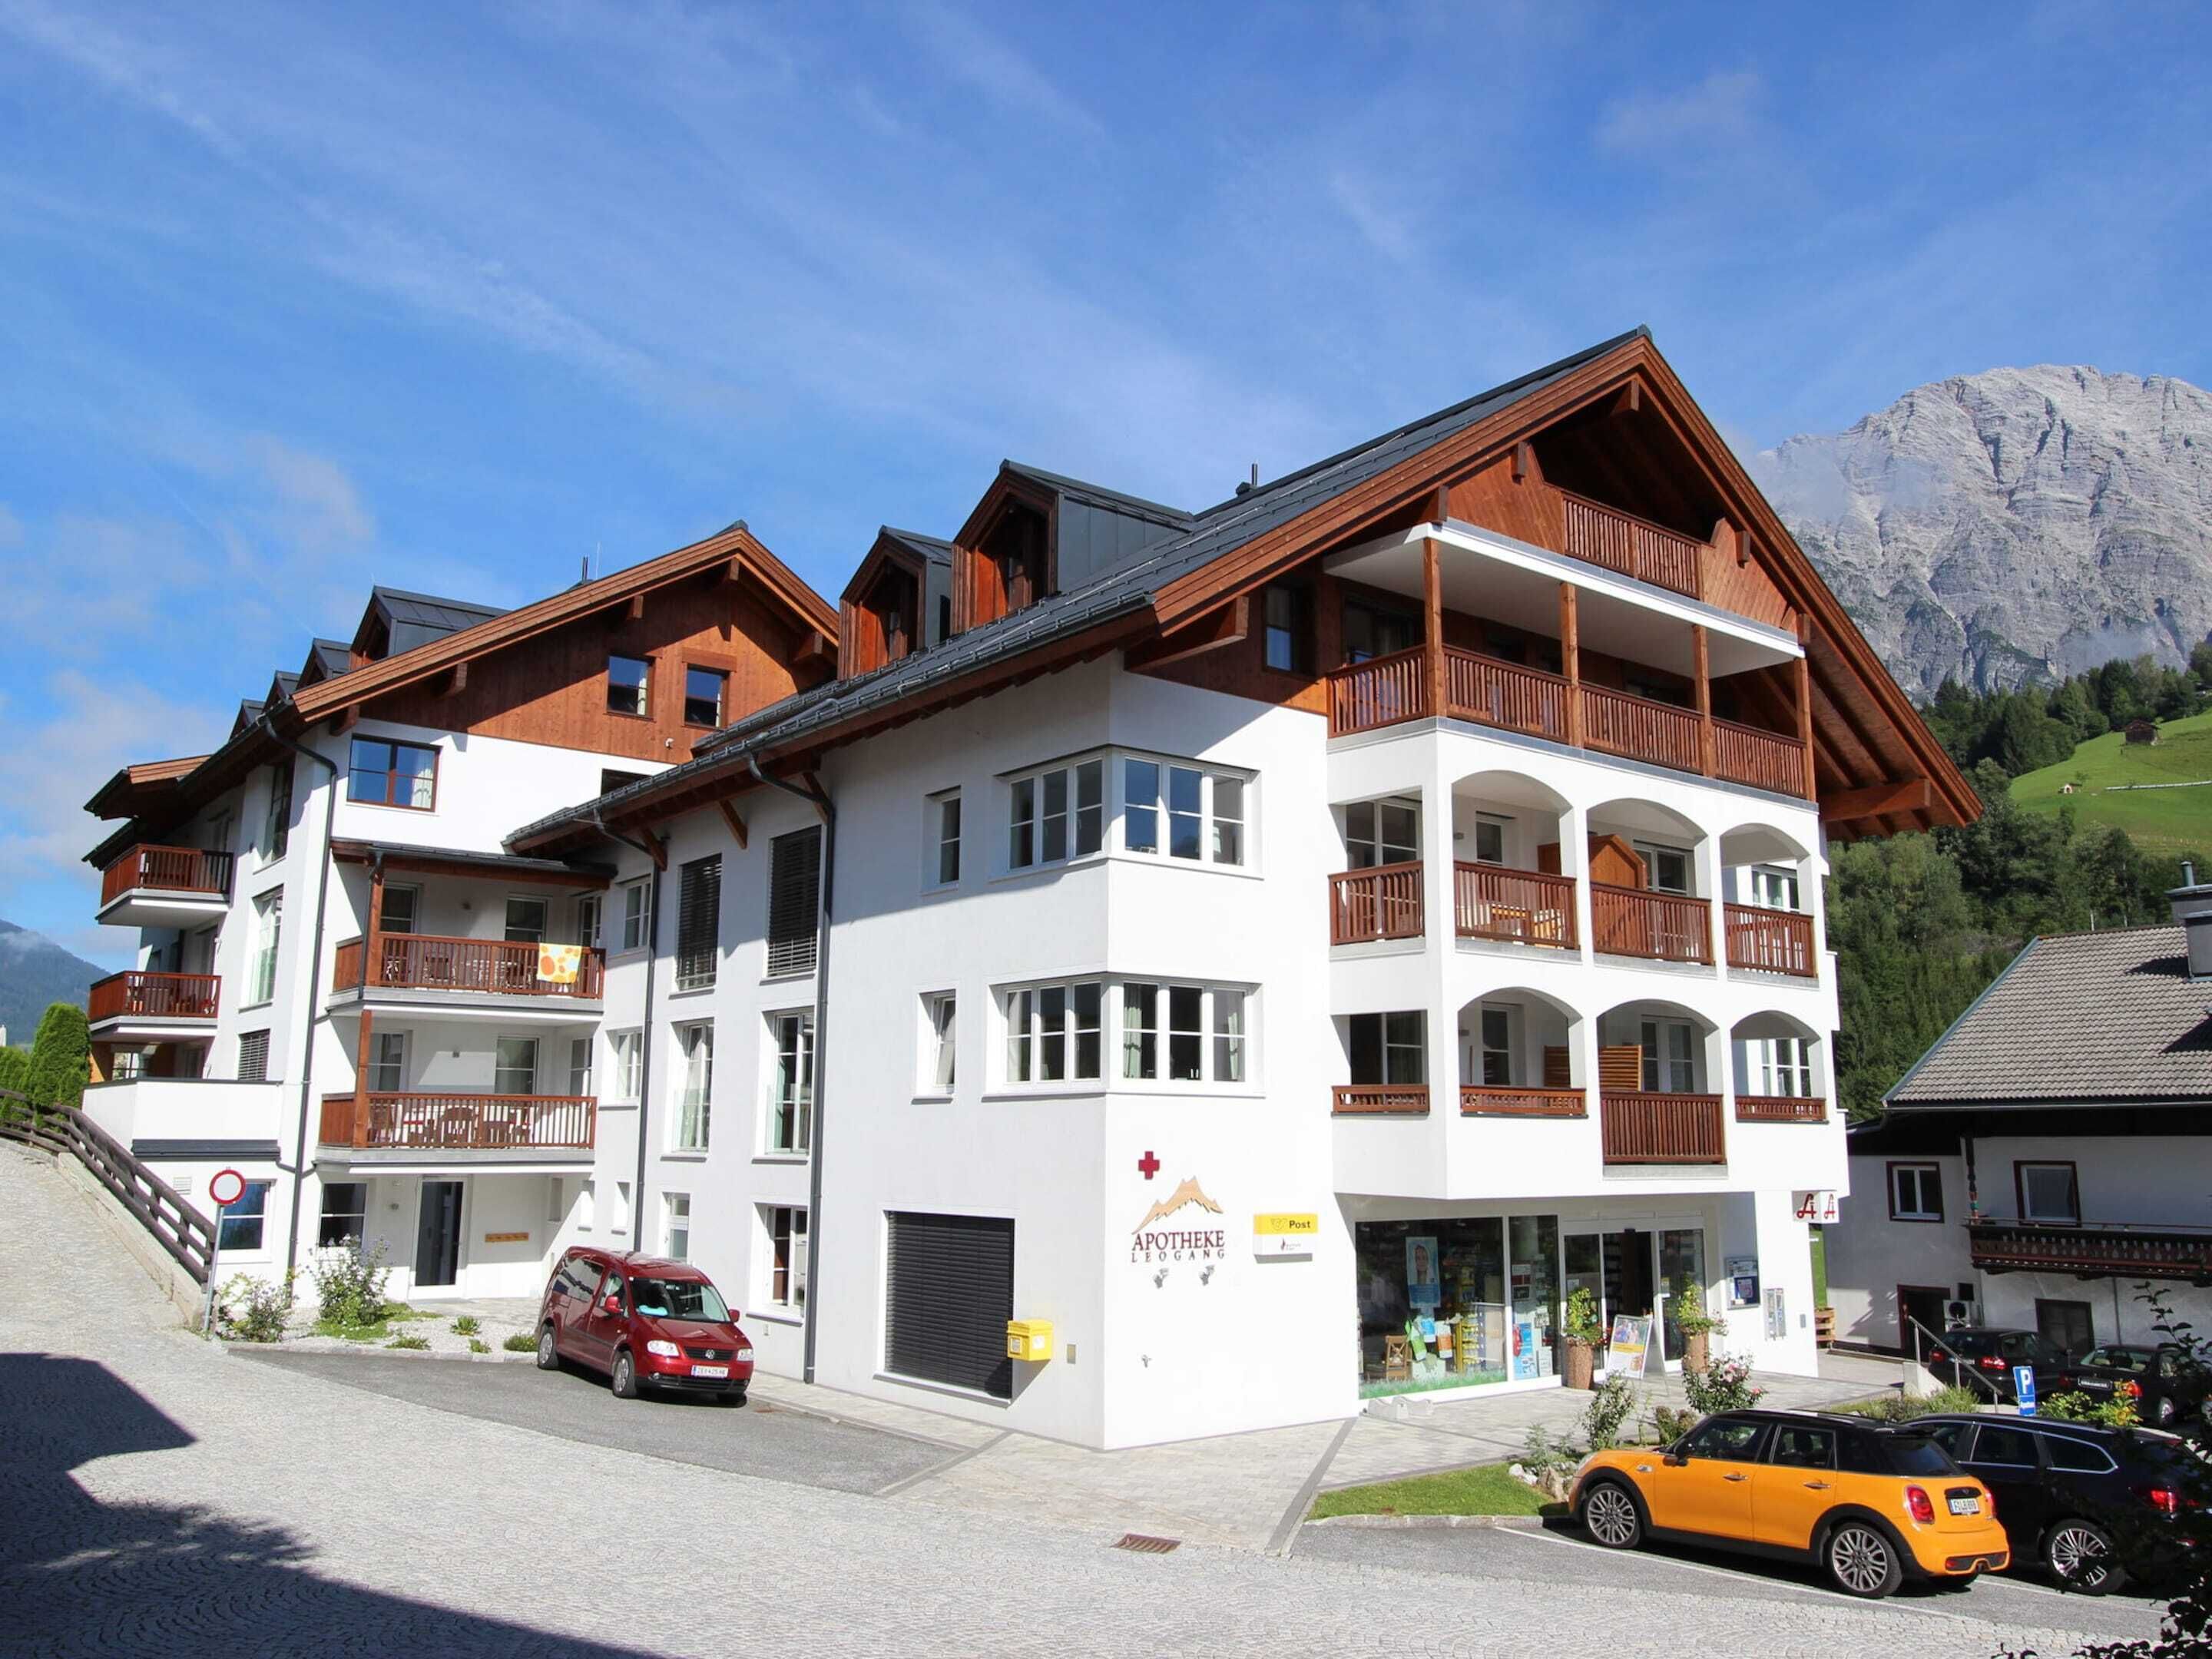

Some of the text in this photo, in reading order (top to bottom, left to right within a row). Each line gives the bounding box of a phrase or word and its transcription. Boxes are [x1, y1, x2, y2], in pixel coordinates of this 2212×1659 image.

[1288, 1220, 1311, 1229] Post
[1131, 1230, 1226, 1251] APOTHEKE
[1131, 1249, 1225, 1263] LEOGANG
[2020, 1369, 2032, 1395] P
